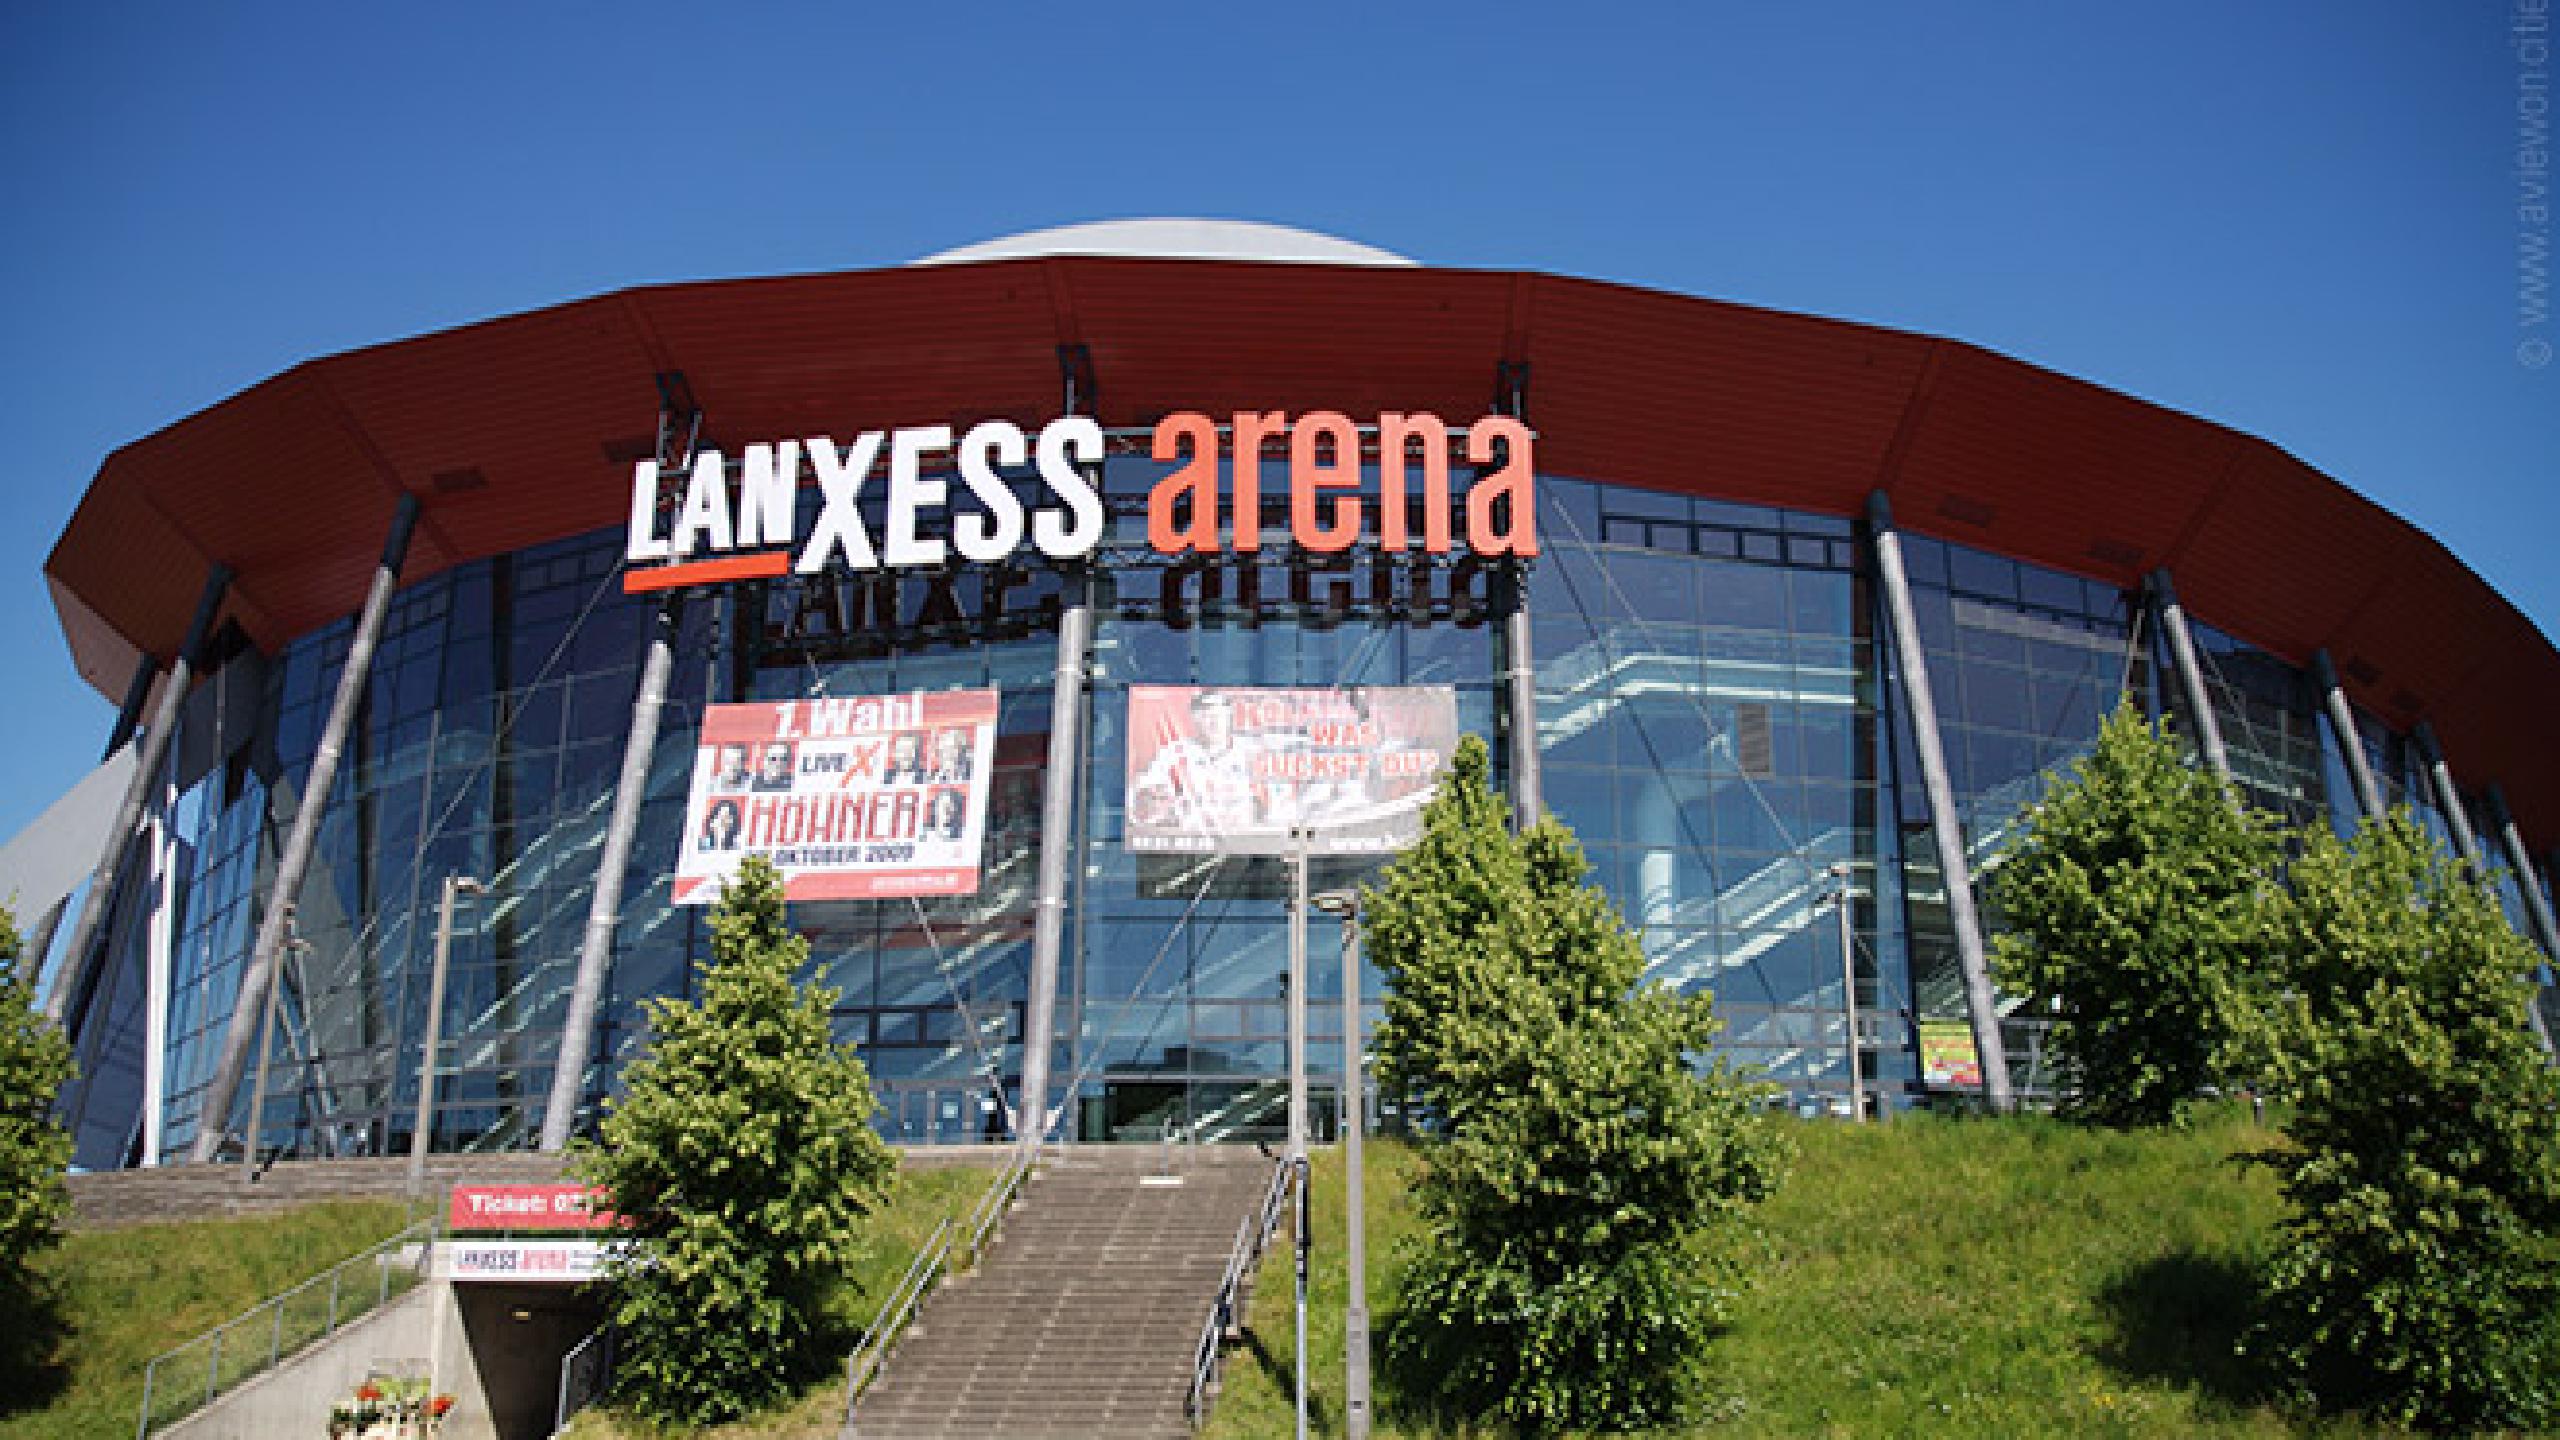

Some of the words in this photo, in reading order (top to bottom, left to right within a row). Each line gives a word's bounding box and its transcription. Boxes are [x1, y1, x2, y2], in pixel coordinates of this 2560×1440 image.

[626, 414, 1105, 573] LANXESS
[1147, 411, 1539, 557] arena
[802, 753, 847, 776] LIVE
[775, 846, 861, 866] OKTOBER
[864, 845, 915, 864] 2009
